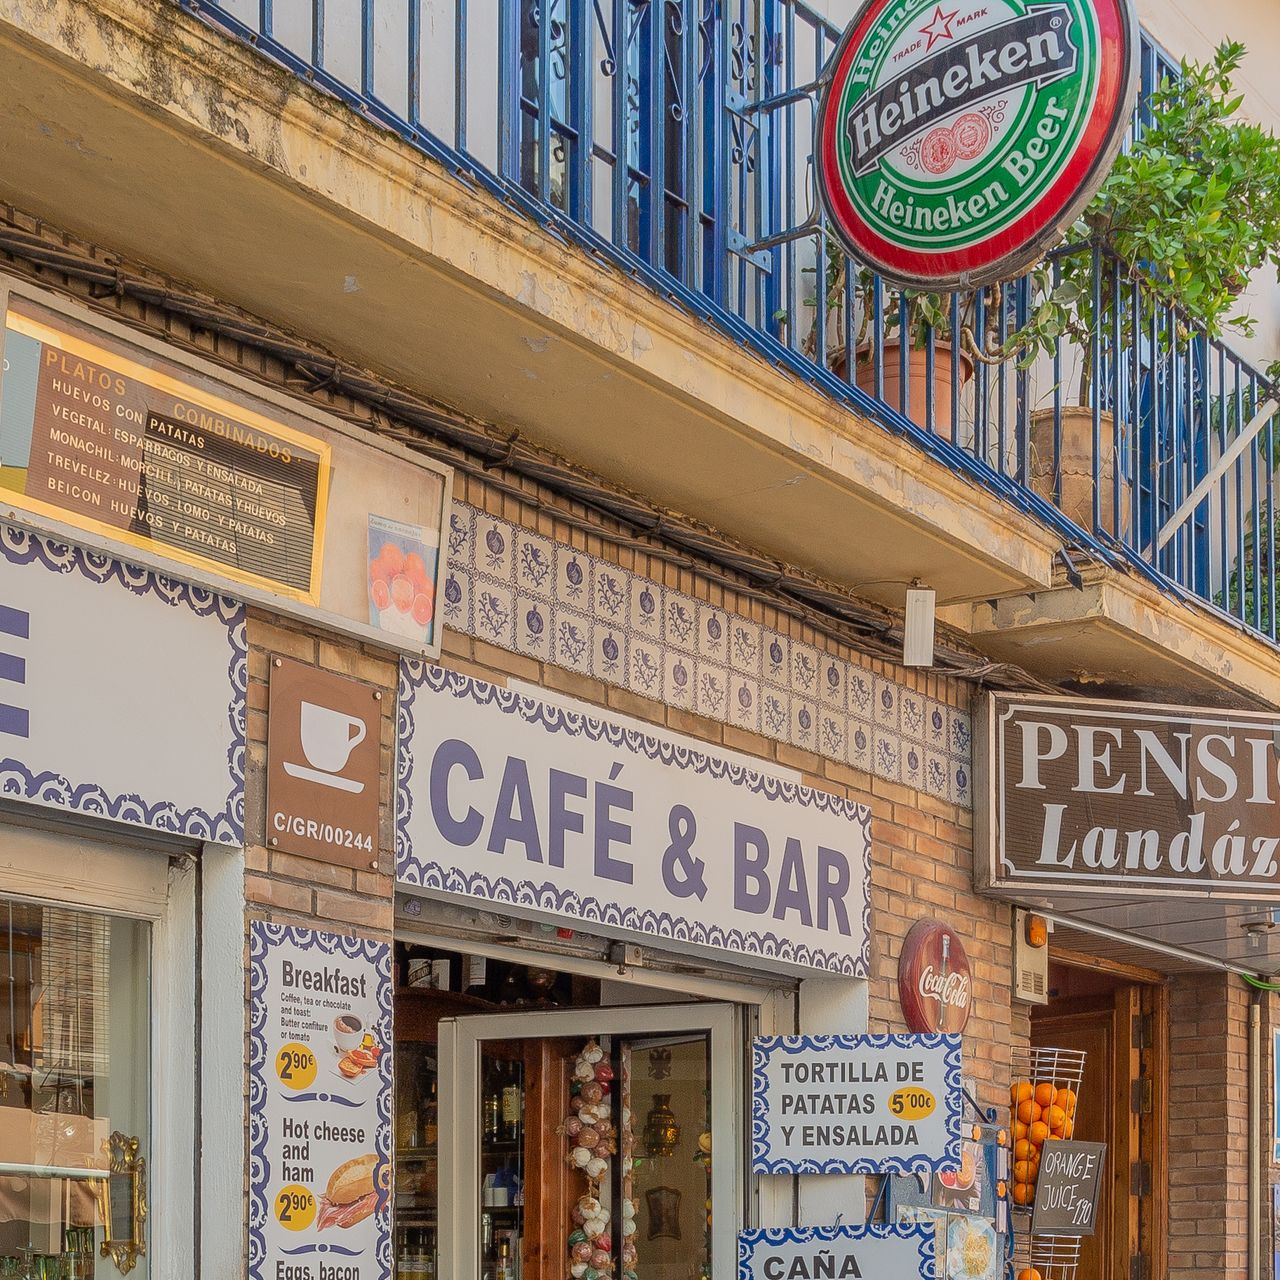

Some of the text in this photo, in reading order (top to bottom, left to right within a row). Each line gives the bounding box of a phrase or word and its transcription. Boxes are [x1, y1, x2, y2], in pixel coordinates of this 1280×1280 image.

[892, 8, 988, 63] TRADE MARK
[852, 30, 1064, 158] Heineken
[872, 96, 1068, 231] Heineken Beer
[46, 351, 291, 464] PLATOS COMBINADOS
[52, 379, 205, 449] HUEVOS CON PATATAS
[114, 429, 191, 467] ESPARRAGOS
[197, 459, 205, 472] Y
[207, 463, 264, 495] ENSALADA
[48, 478, 237, 553] BEICON HUEVOS Y PATATAS
[185, 480, 232, 507] PATATAS
[235, 499, 244, 511] Y
[243, 502, 287, 526] HUEVOS
[177, 501, 209, 520] LOMO
[217, 516, 227, 528] Y
[229, 518, 274, 544] PATATAS
[273, 812, 373, 854] C/GR/00244
[430, 739, 851, 936] CAFÉ & BAR
[282, 960, 366, 998] Breakfast
[281, 993, 302, 1006] Coffee,
[304, 996, 313, 1006] tea
[323, 998, 351, 1011] chocolate
[281, 1006, 291, 1016] and
[281, 1017, 328, 1032] Butter confiture
[281, 1031, 310, 1041] or tomato
[781, 1061, 924, 1083] TORTILLA DE
[781, 1094, 875, 1115] PATATAS
[283, 1118, 365, 1143] Hot cheese
[782, 1125, 919, 1146] Y ENSALADA
[283, 1141, 309, 1160] and
[283, 1162, 313, 1182] ham
[1045, 1152, 1096, 1180] ORANGE
[1041, 1184, 1077, 1211] JUICE
[763, 1250, 862, 1280] CAÑA
